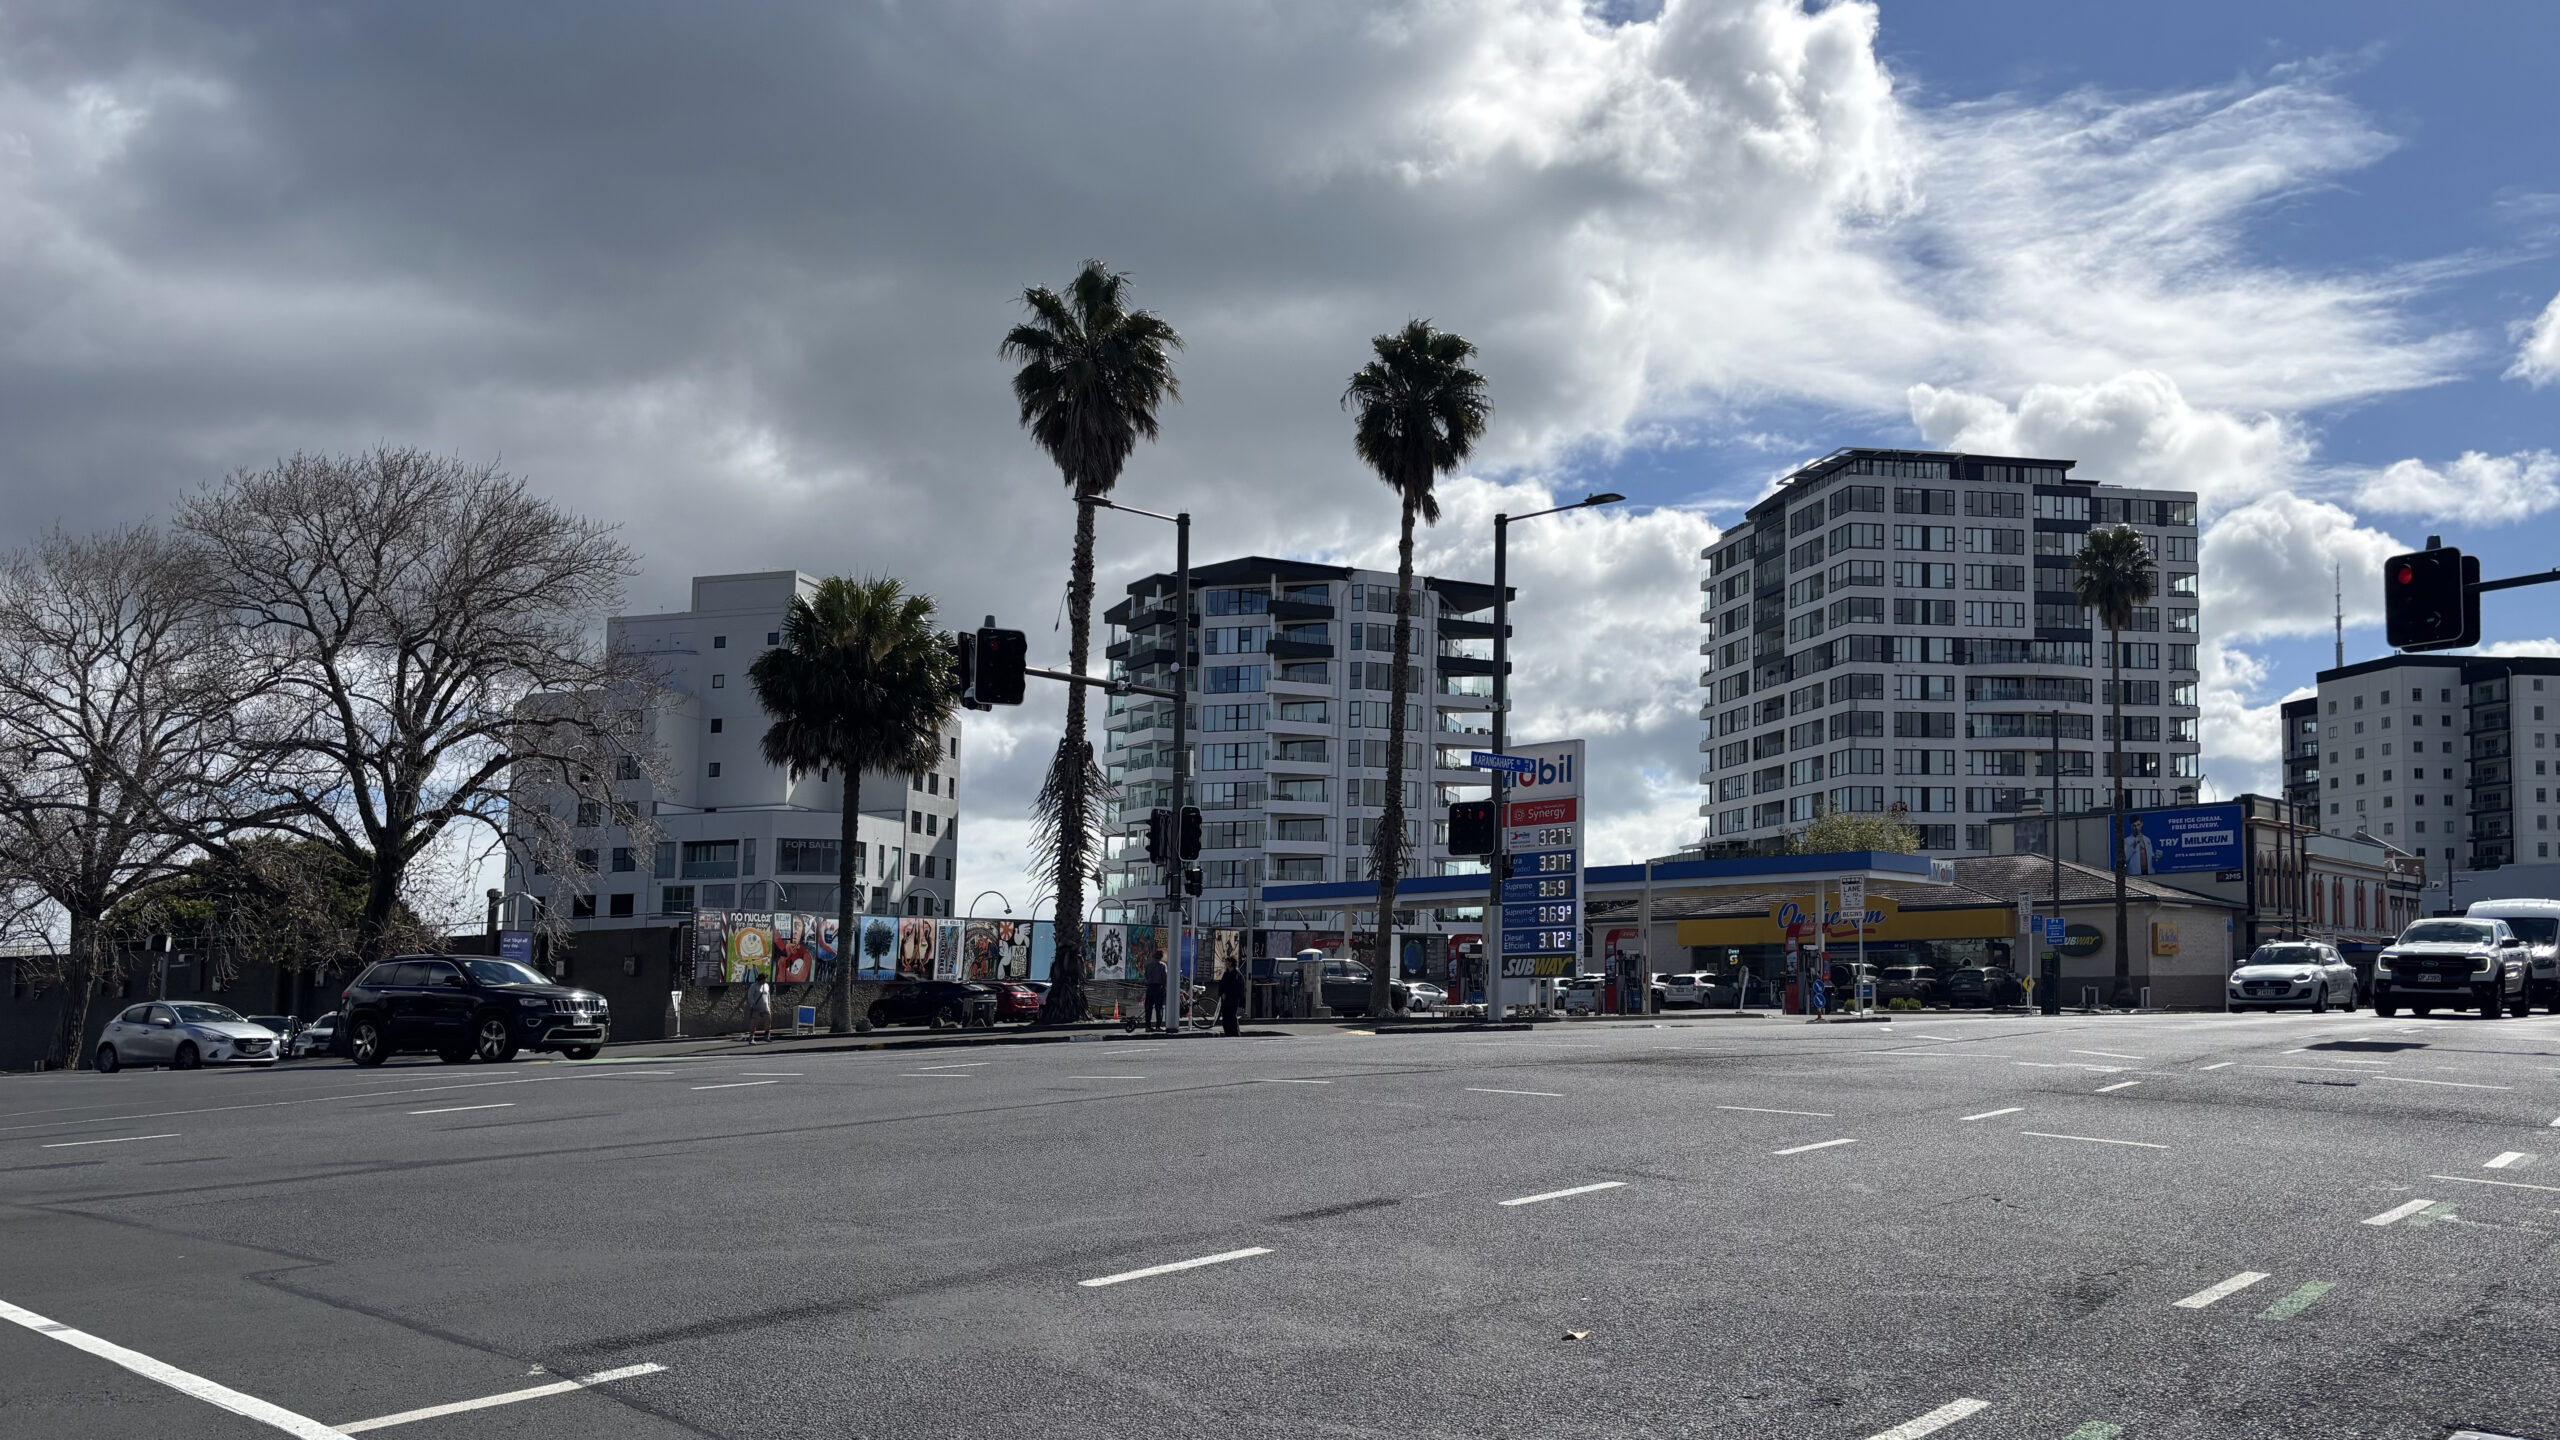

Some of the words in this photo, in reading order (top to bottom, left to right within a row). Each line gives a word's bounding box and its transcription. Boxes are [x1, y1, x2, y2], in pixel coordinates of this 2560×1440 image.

[1473, 754, 1514, 770] KARANGAHAPE
[1528, 808, 1566, 821] Synergy
[2159, 838, 2179, 847] TRY
[2184, 835, 2228, 845] MILKRUN
[2064, 936, 2099, 945] UBWAY
[1014, 946, 1025, 956] NO
[1503, 957, 1573, 976] SUBWAY
